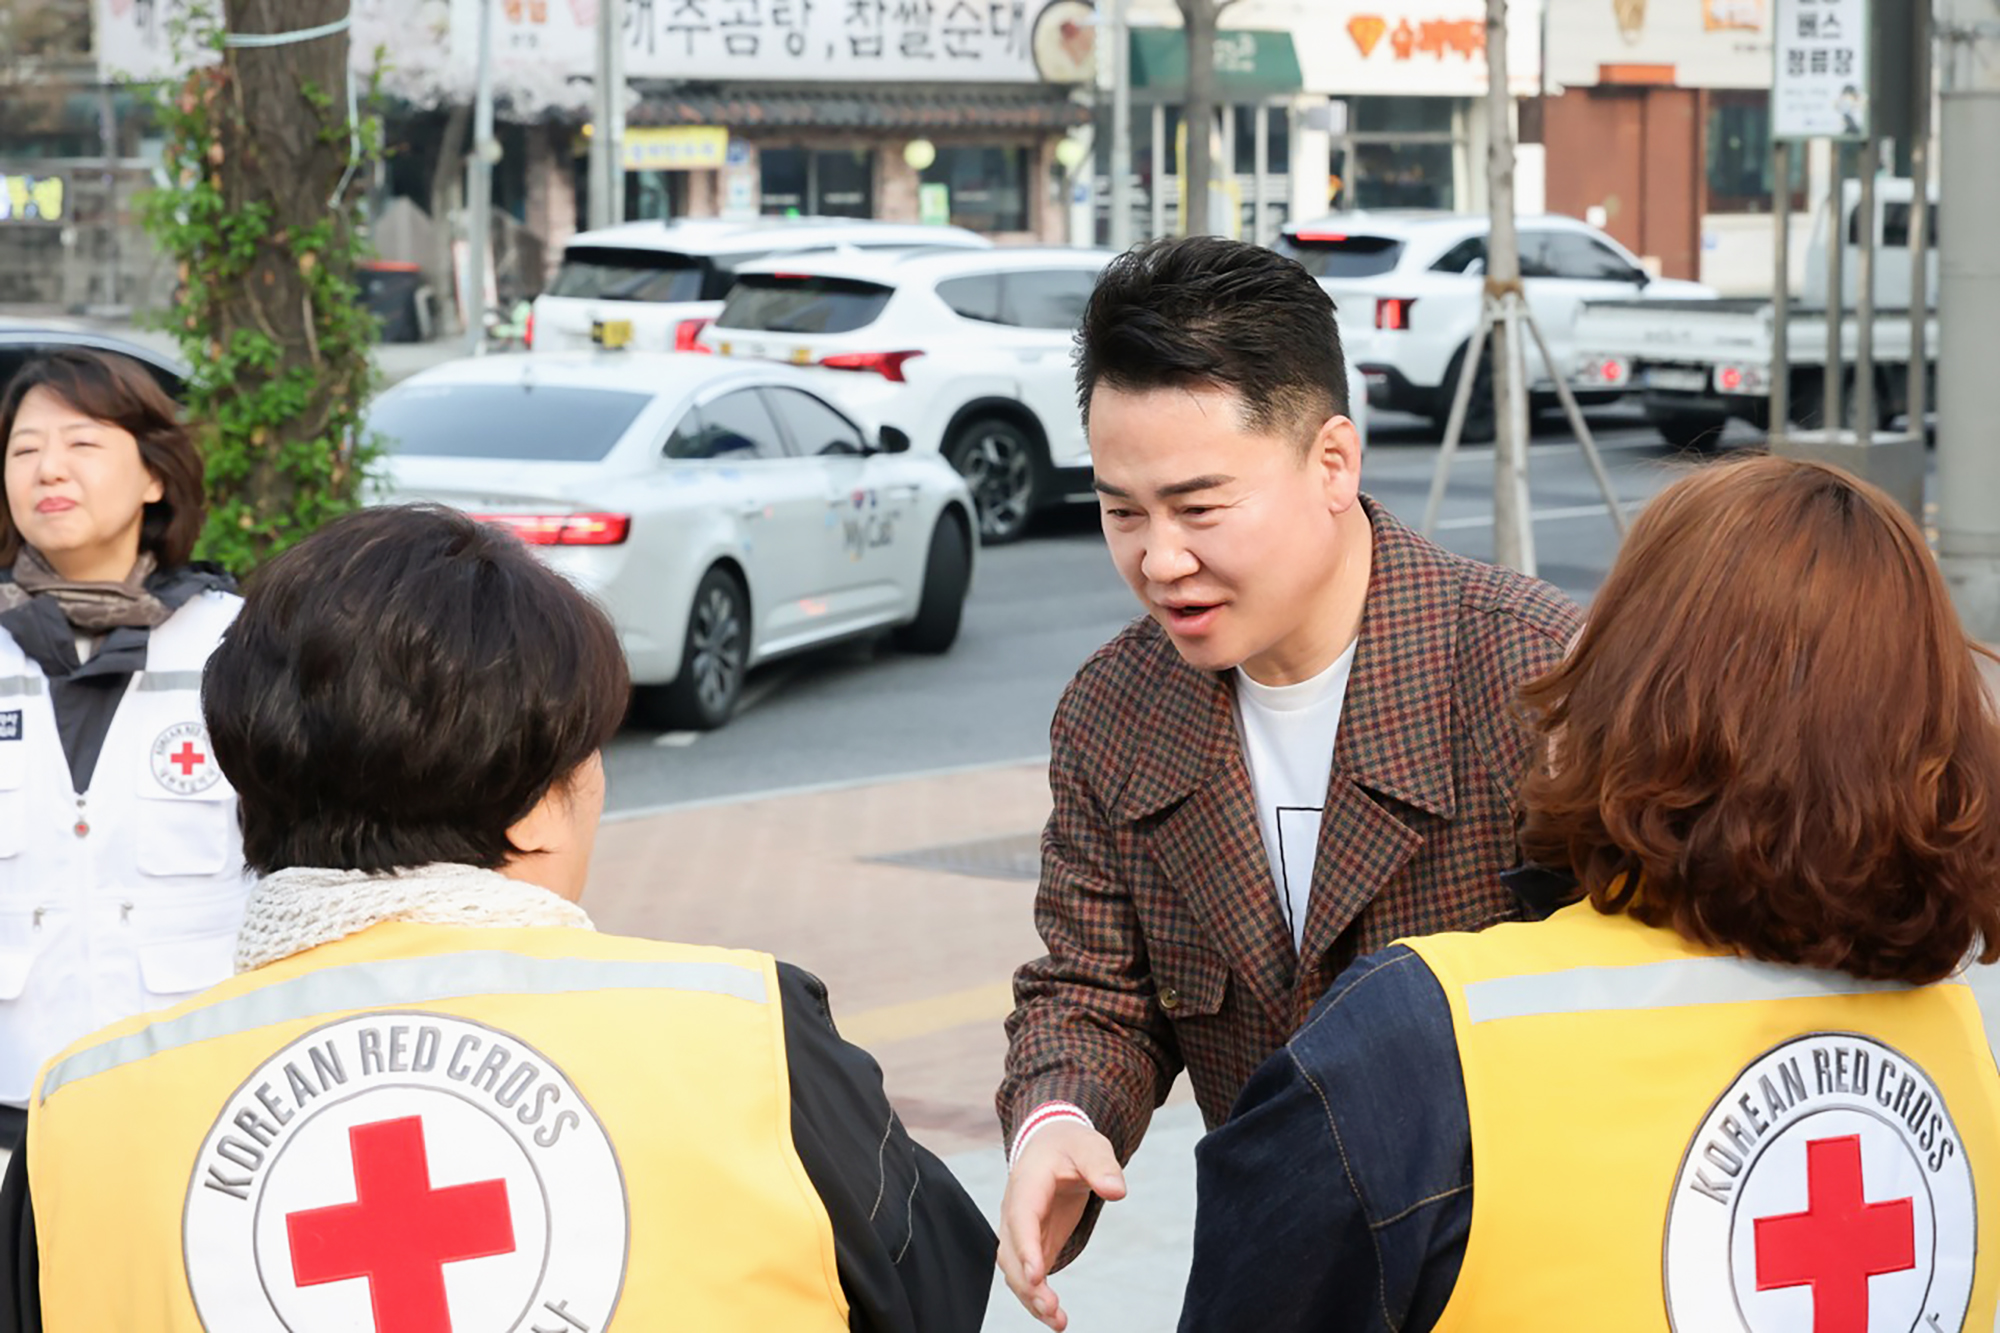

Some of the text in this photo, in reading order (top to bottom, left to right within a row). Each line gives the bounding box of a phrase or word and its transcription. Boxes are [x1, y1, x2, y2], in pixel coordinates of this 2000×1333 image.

[204, 1026, 580, 1200] KOREAN RED CROSS
[1690, 1047, 1954, 1205] KOREAN RED CROSS
